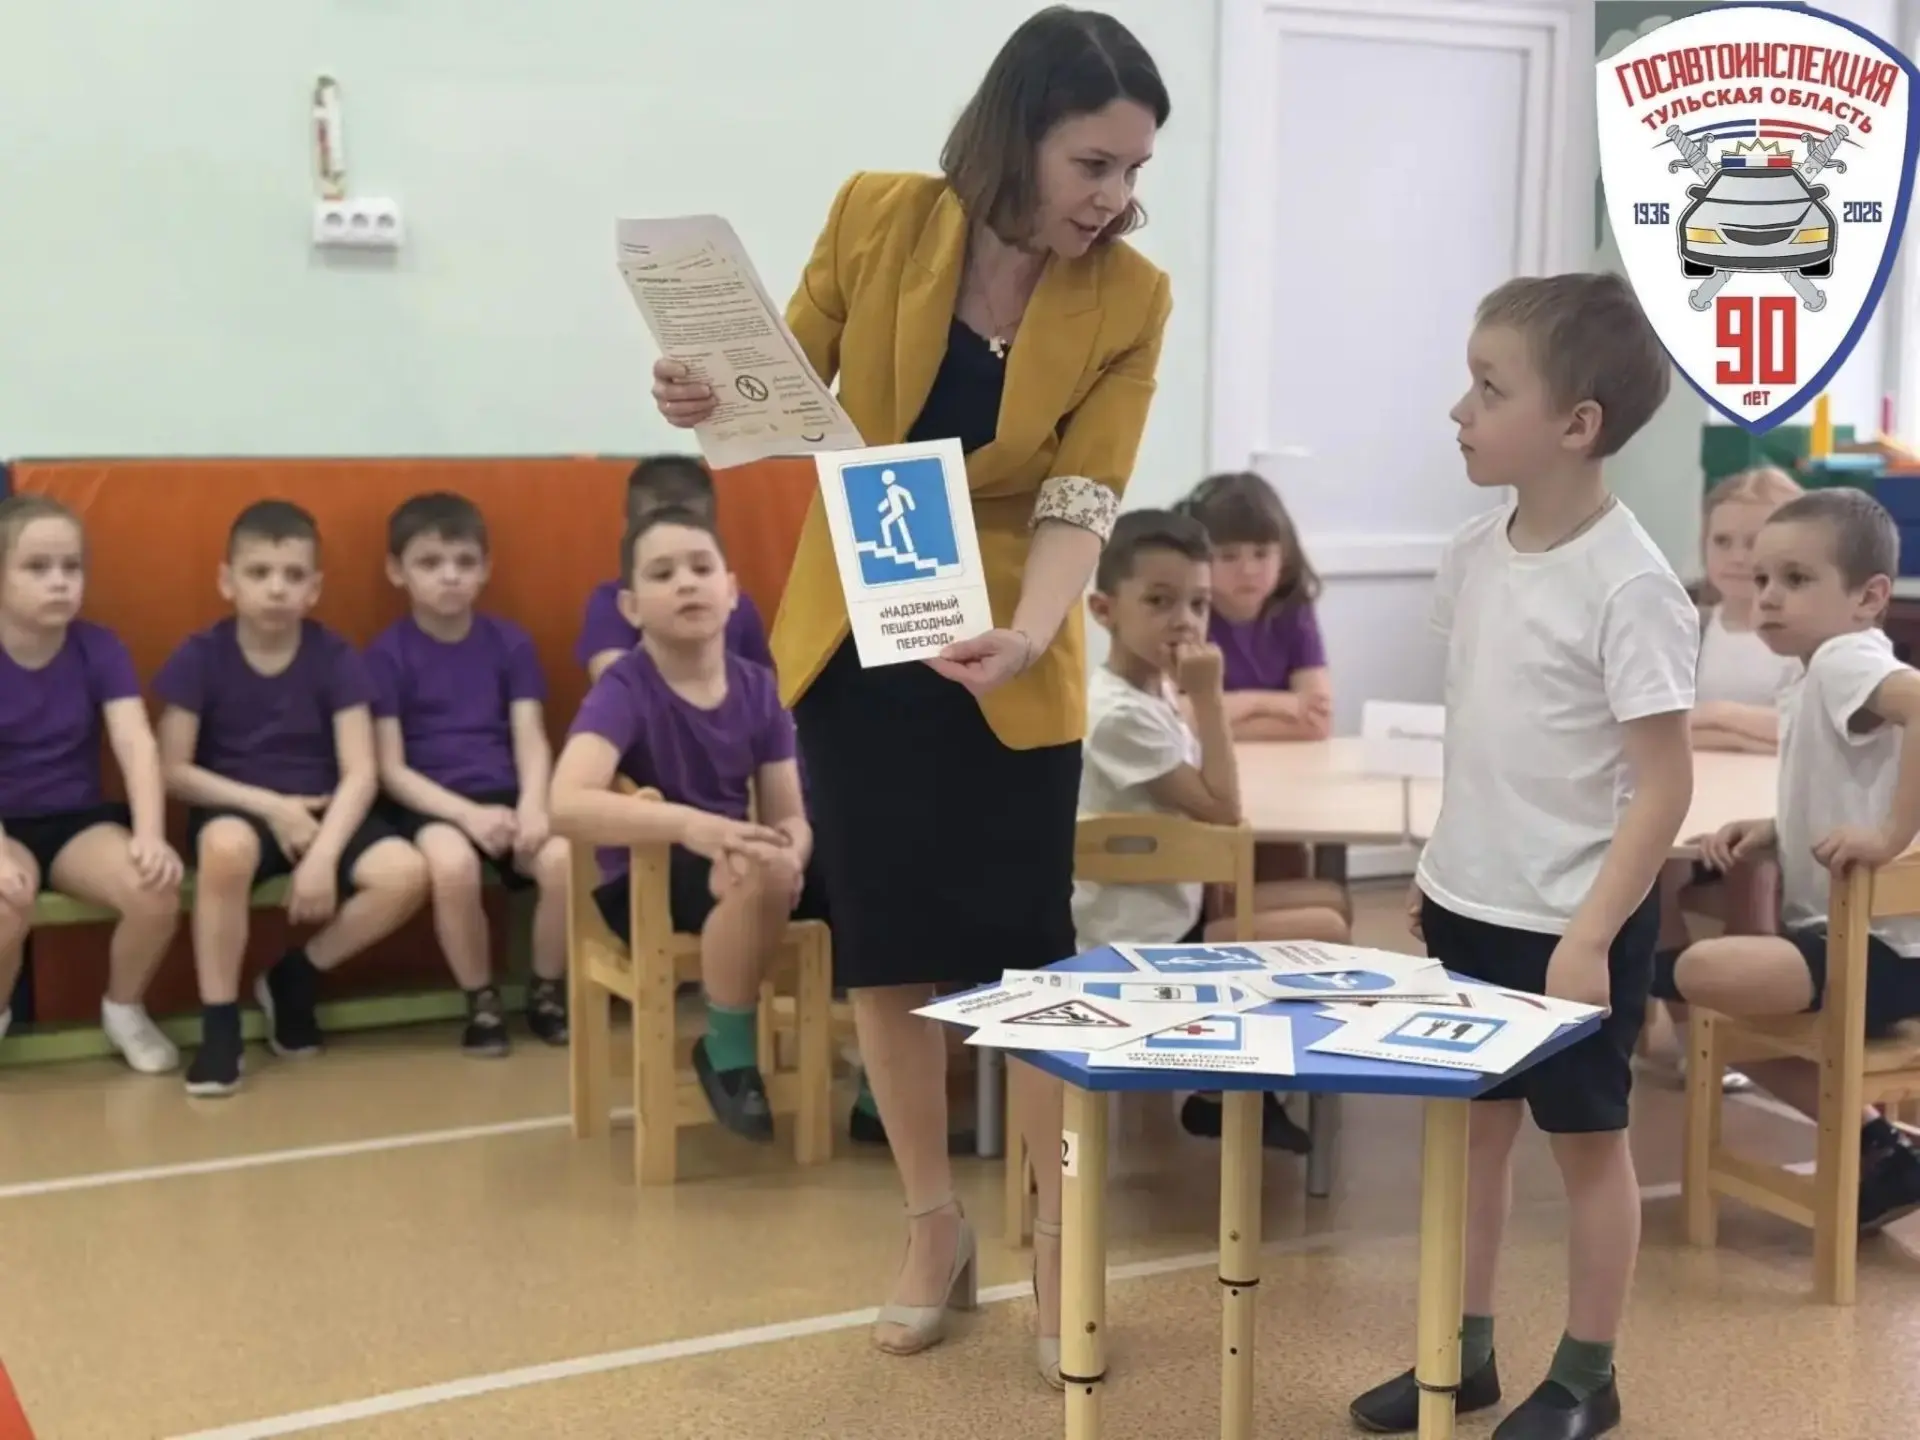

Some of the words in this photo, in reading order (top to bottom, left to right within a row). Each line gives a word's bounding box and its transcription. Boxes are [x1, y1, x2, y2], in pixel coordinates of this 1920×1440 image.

[880, 595, 959, 618] «НАДЗЕМНЫЙ
[881, 612, 964, 635] ПЕШЕХОДНЫЙ
[896, 632, 955, 650] ПЕРЕХОД»
